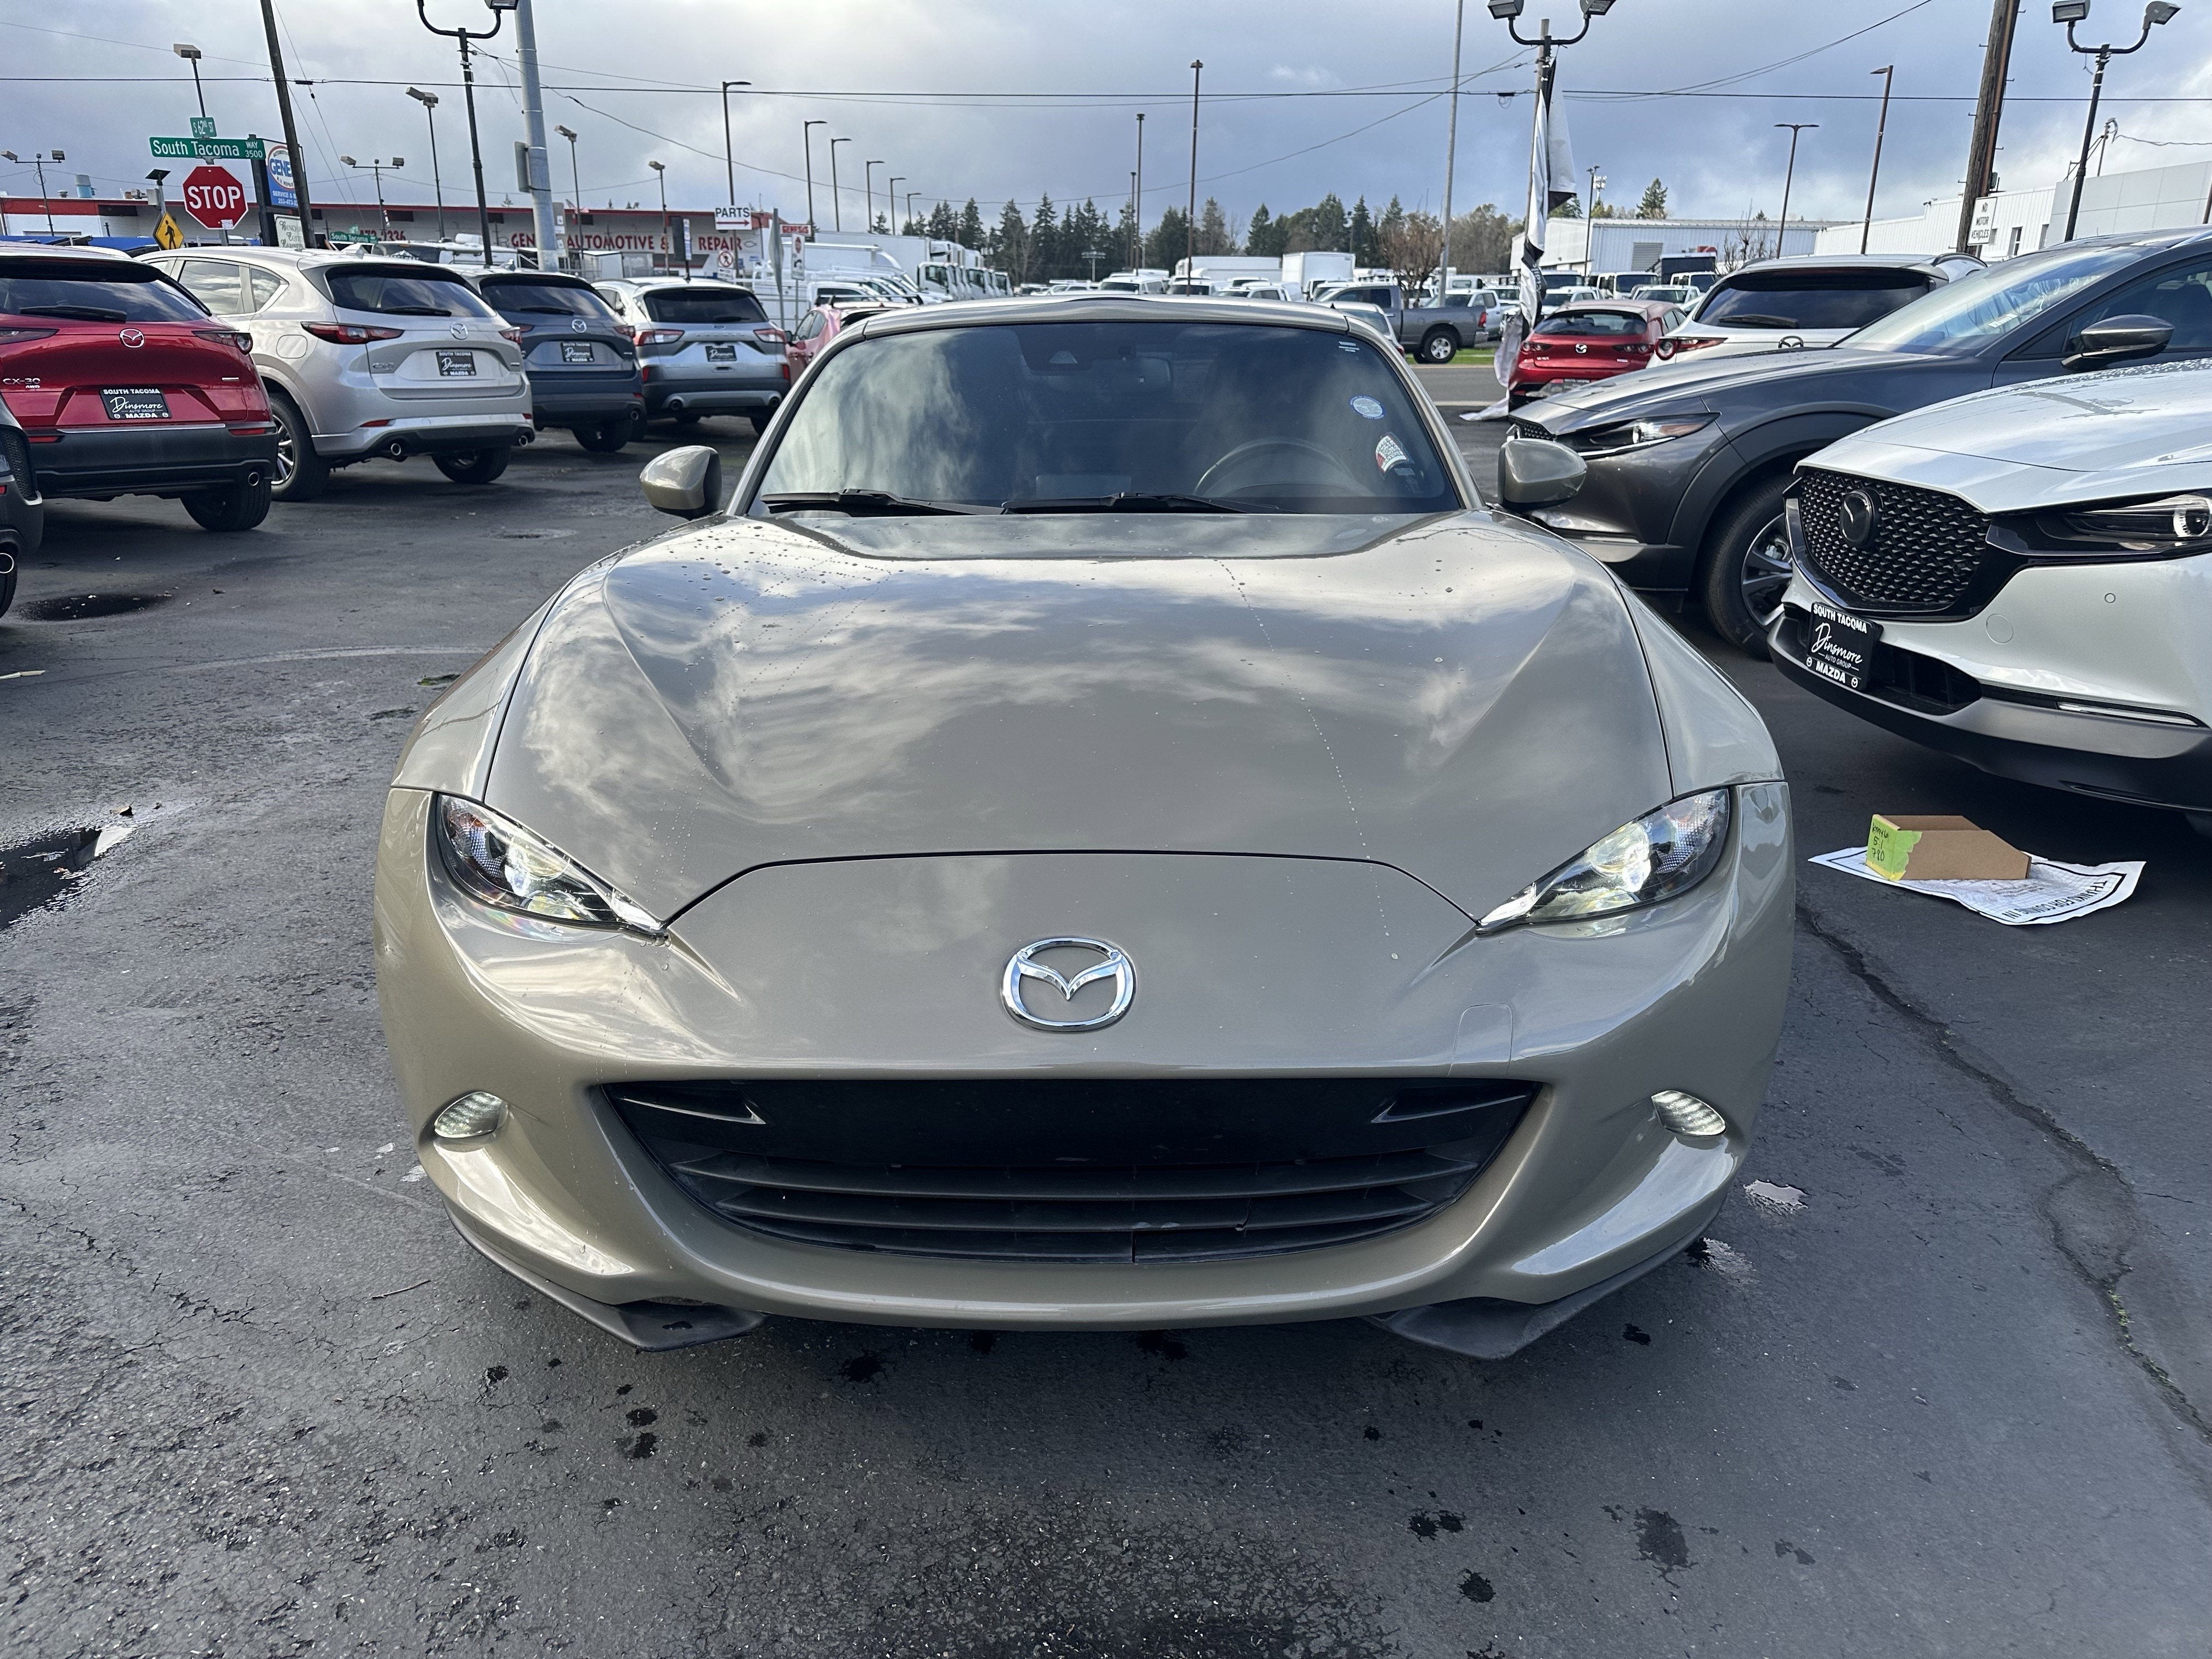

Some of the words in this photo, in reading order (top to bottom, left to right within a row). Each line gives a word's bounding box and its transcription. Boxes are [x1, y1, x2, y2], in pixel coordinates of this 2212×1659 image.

[193, 122, 198, 133] S
[153, 140, 188, 155] South
[191, 140, 240, 156] Tacoma
[245, 141, 258, 149] WAY
[245, 150, 263, 158] 3500
[187, 185, 241, 210] STOP
[272, 190, 289, 198] SERVICE
[715, 207, 751, 218] PARTS
[566, 234, 654, 250] AUTOMOTIVE
[698, 236, 743, 251] REPAIR
[110, 396, 163, 413] Dinsmore
[1813, 603, 1836, 622] SOUTH
[1837, 612, 1867, 634] TACOMA
[1811, 622, 1863, 664] Dinsmore
[1824, 653, 1836, 664] AUTO
[1836, 658, 1852, 669] GROUP
[1815, 661, 1846, 684] MAZDA
[1872, 847, 1885, 861] 780
